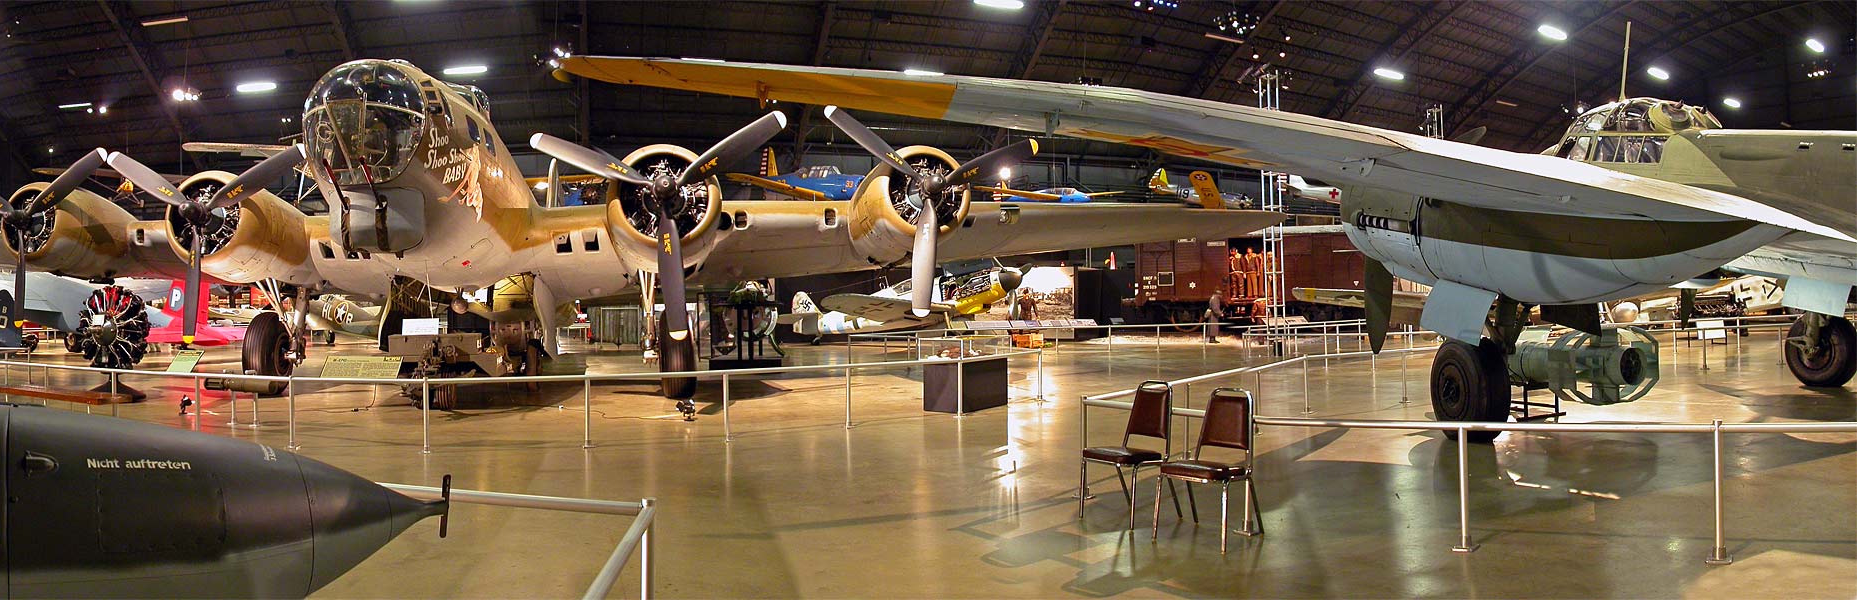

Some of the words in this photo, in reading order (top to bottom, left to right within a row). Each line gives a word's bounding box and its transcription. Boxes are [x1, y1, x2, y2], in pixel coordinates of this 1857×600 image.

[428, 127, 449, 149] Shoo
[424, 149, 447, 170] Shoo
[442, 162, 467, 185] BABY
[171, 288, 182, 308] P
[322, 302, 333, 321] HL
[87, 459, 120, 469] Nicht
[125, 459, 191, 470] auftreten
